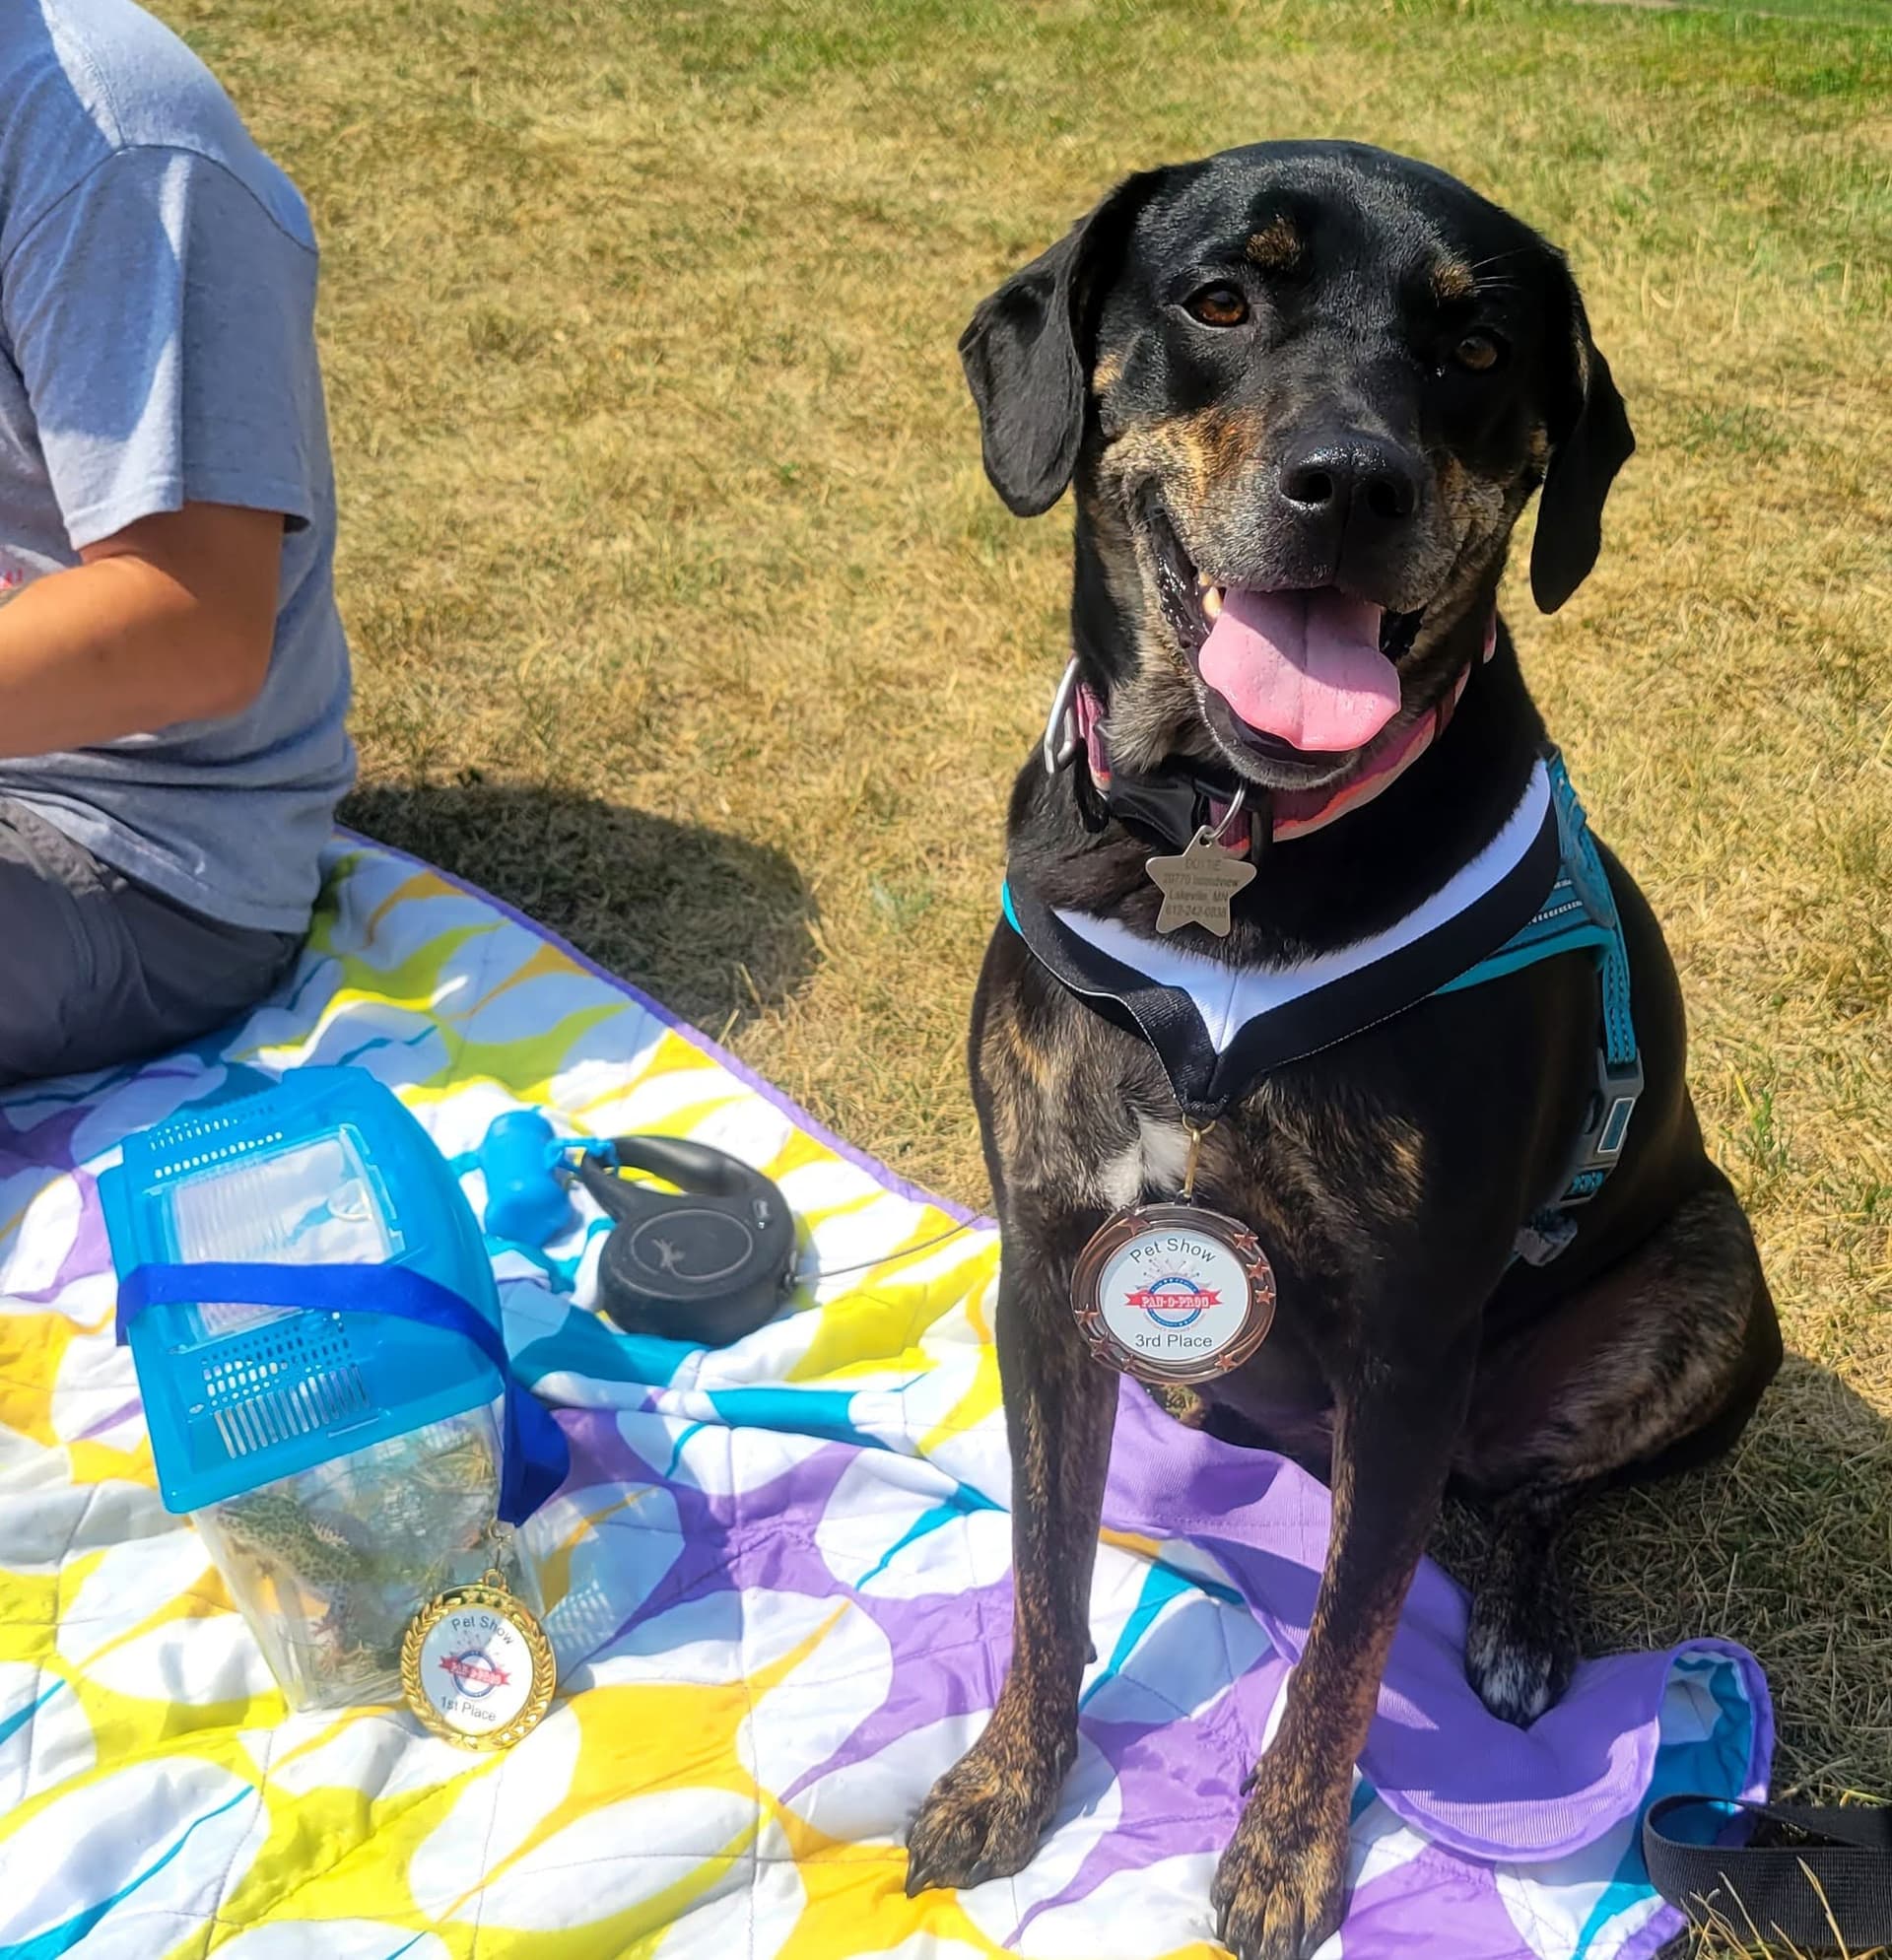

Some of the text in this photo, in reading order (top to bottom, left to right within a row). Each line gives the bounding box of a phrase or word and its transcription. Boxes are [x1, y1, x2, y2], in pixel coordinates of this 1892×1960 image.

[1129, 1238, 1217, 1263] Pet Show
[1135, 1333, 1213, 1347] 3rd Place
[451, 1615, 513, 1645] Pet Show
[440, 1696, 497, 1722] 1st Place
